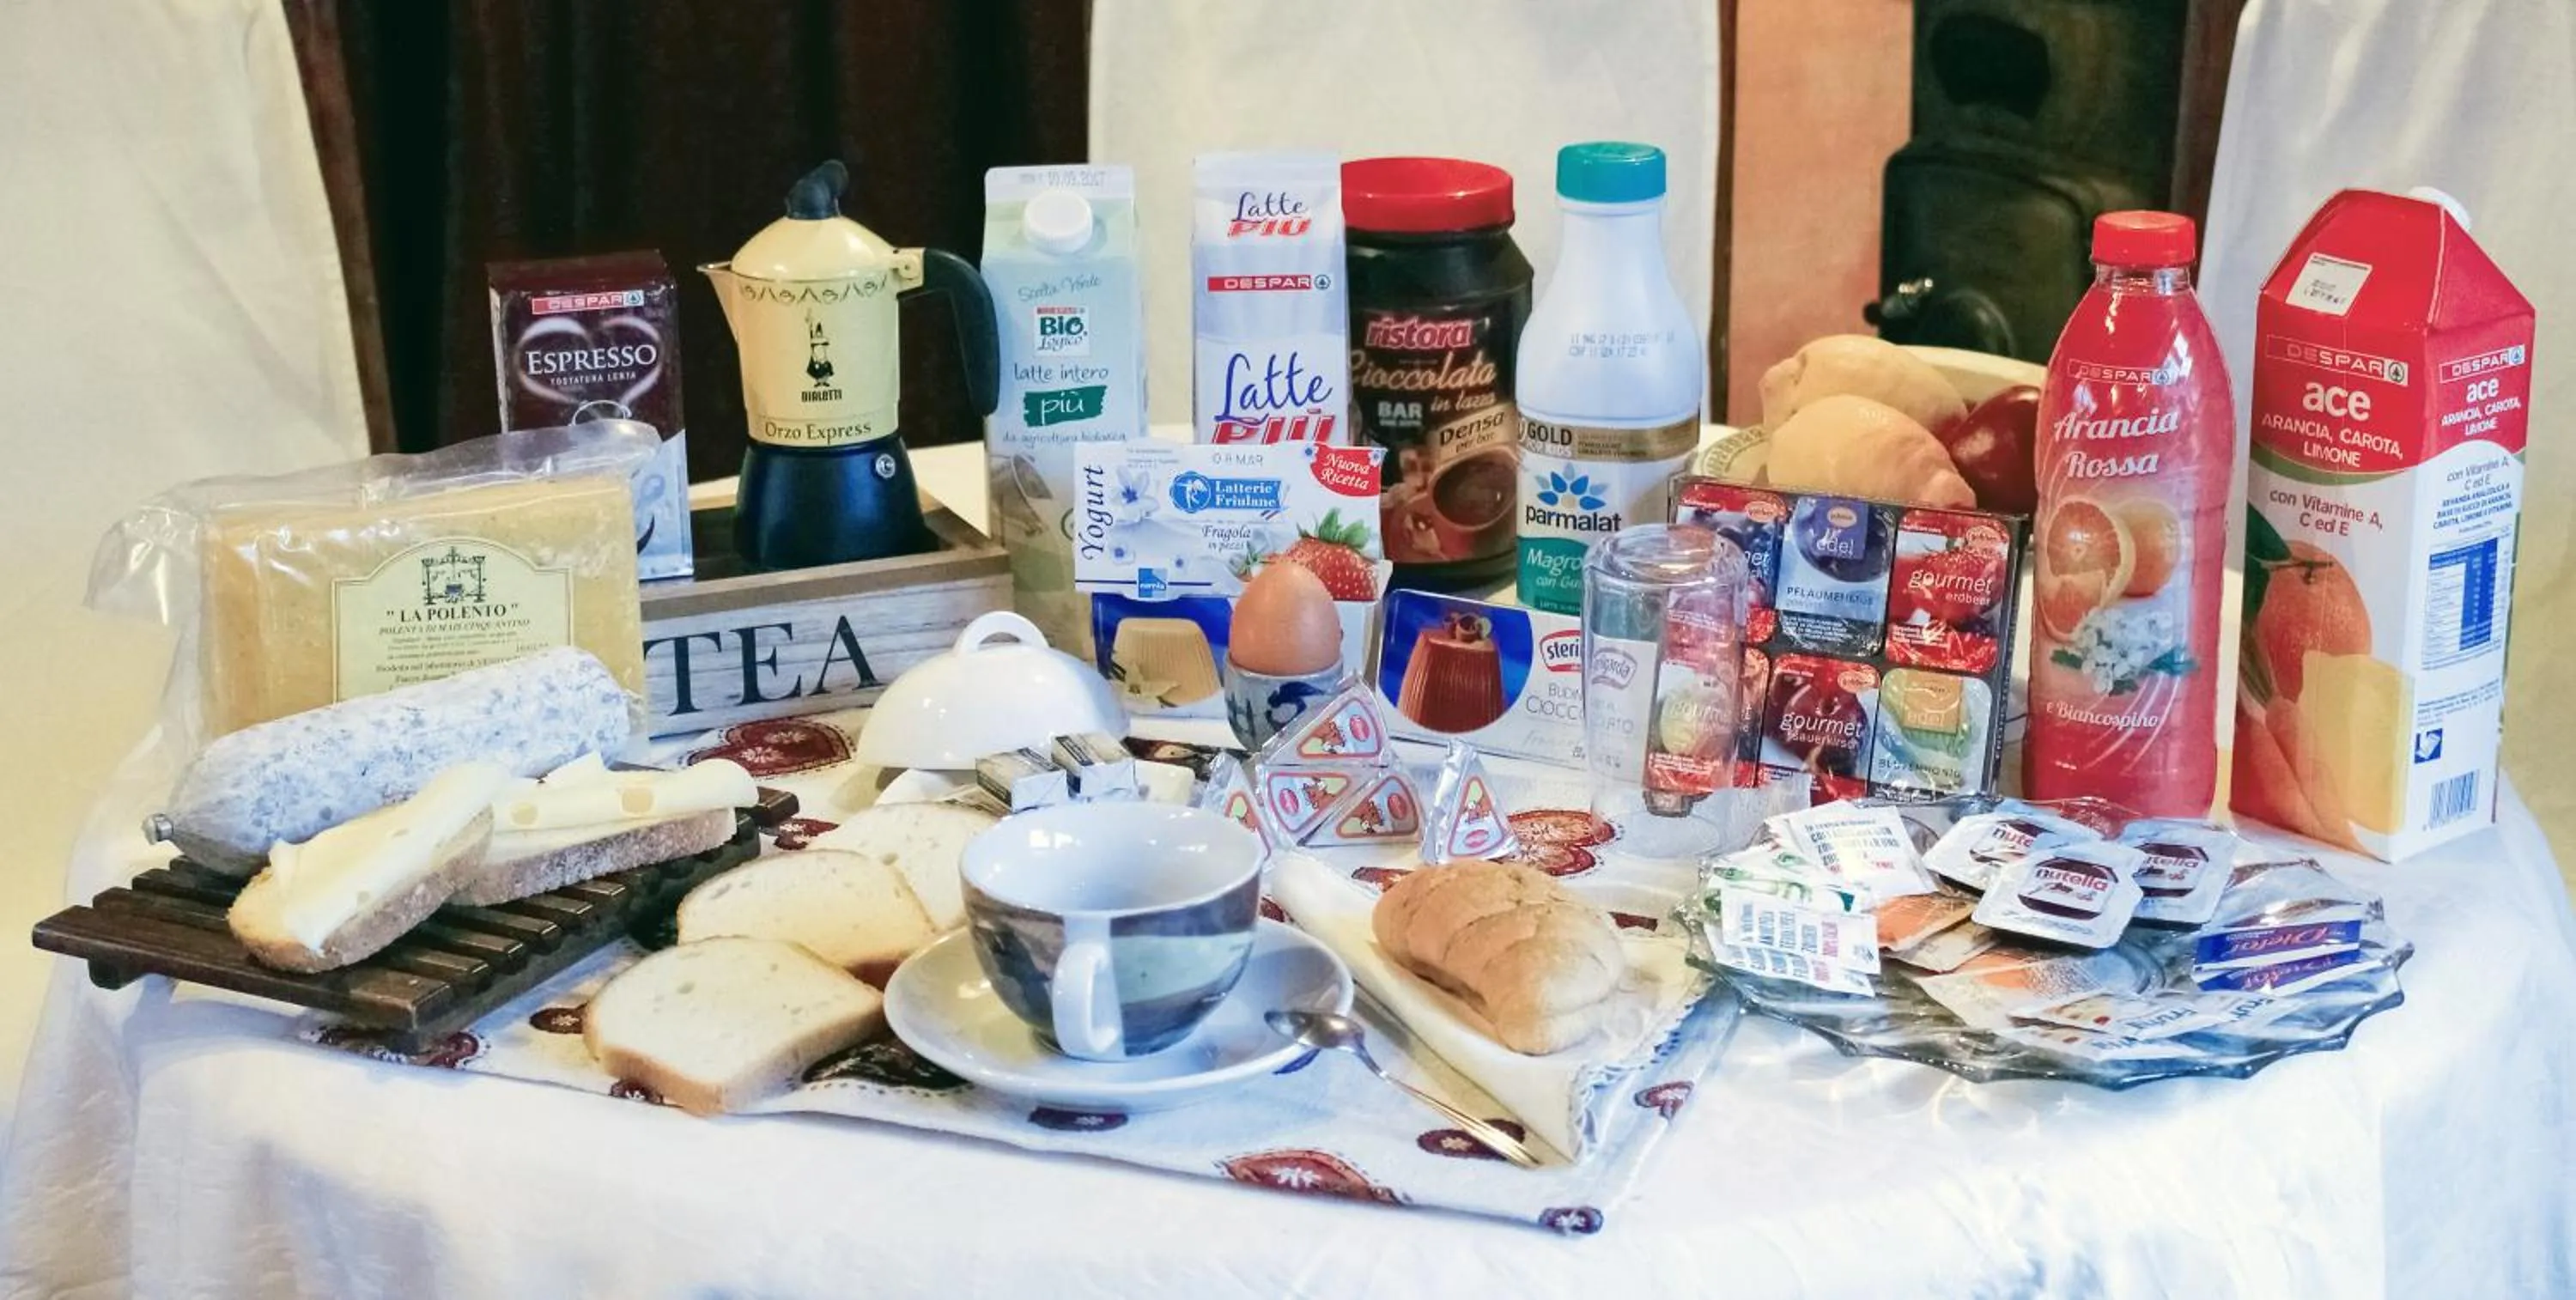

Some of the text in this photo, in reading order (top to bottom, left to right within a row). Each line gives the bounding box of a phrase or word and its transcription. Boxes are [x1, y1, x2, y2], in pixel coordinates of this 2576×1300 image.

[1230, 191, 1307, 222] Latte
[1223, 276, 1310, 290] DESPAR
[548, 294, 624, 310] DESPAR
[1366, 316, 1473, 349] ristora
[525, 343, 658, 376] ESPRESSO
[1349, 348, 1498, 390] Cioccolata
[2287, 342, 2384, 377] DESPAR
[2451, 354, 2509, 378] DESPAR
[550, 374, 605, 386] TOSTATURA
[1013, 363, 1109, 384] latte intero
[2078, 365, 2152, 382] DESPAR
[1213, 350, 1334, 425] Latte
[2302, 380, 2371, 421] ace
[2466, 377, 2500, 403] ace
[1041, 390, 1084, 424] più
[1377, 400, 1423, 419] BAR
[764, 421, 872, 445] Orzo Express
[1527, 423, 1573, 446] GOLD
[2053, 407, 2179, 442] Arancia
[2262, 413, 2404, 461] ARANCIA, CAROTA,
[2464, 418, 2499, 437] LIMONE
[1324, 451, 1370, 475] Nuova
[2064, 450, 2160, 478] Rossa
[2303, 440, 2361, 467] LIMONE
[1215, 480, 1273, 495] Latterie
[1321, 468, 1370, 491] Ricetta
[2446, 467, 2465, 483] con
[2464, 473, 2492, 492] C ed E
[1078, 464, 1114, 561] Yogurt
[1215, 495, 1277, 508] Friulane
[2269, 489, 2384, 532] con Vitamine A,
[1525, 503, 1622, 532] parmalat
[2299, 512, 2349, 537] C ed E
[1201, 525, 1252, 542] Fragola
[1815, 536, 1855, 558] edel
[1526, 547, 1583, 577] Magro
[1535, 576, 1557, 590] con
[1908, 568, 1993, 595] gourmet
[399, 609, 422, 623] LA
[427, 603, 507, 622] POLENTO
[642, 615, 887, 717] TEA
[1779, 712, 1864, 738] gourmet
[2057, 701, 2160, 731] Biancospino
[2036, 864, 2109, 892] nutella
